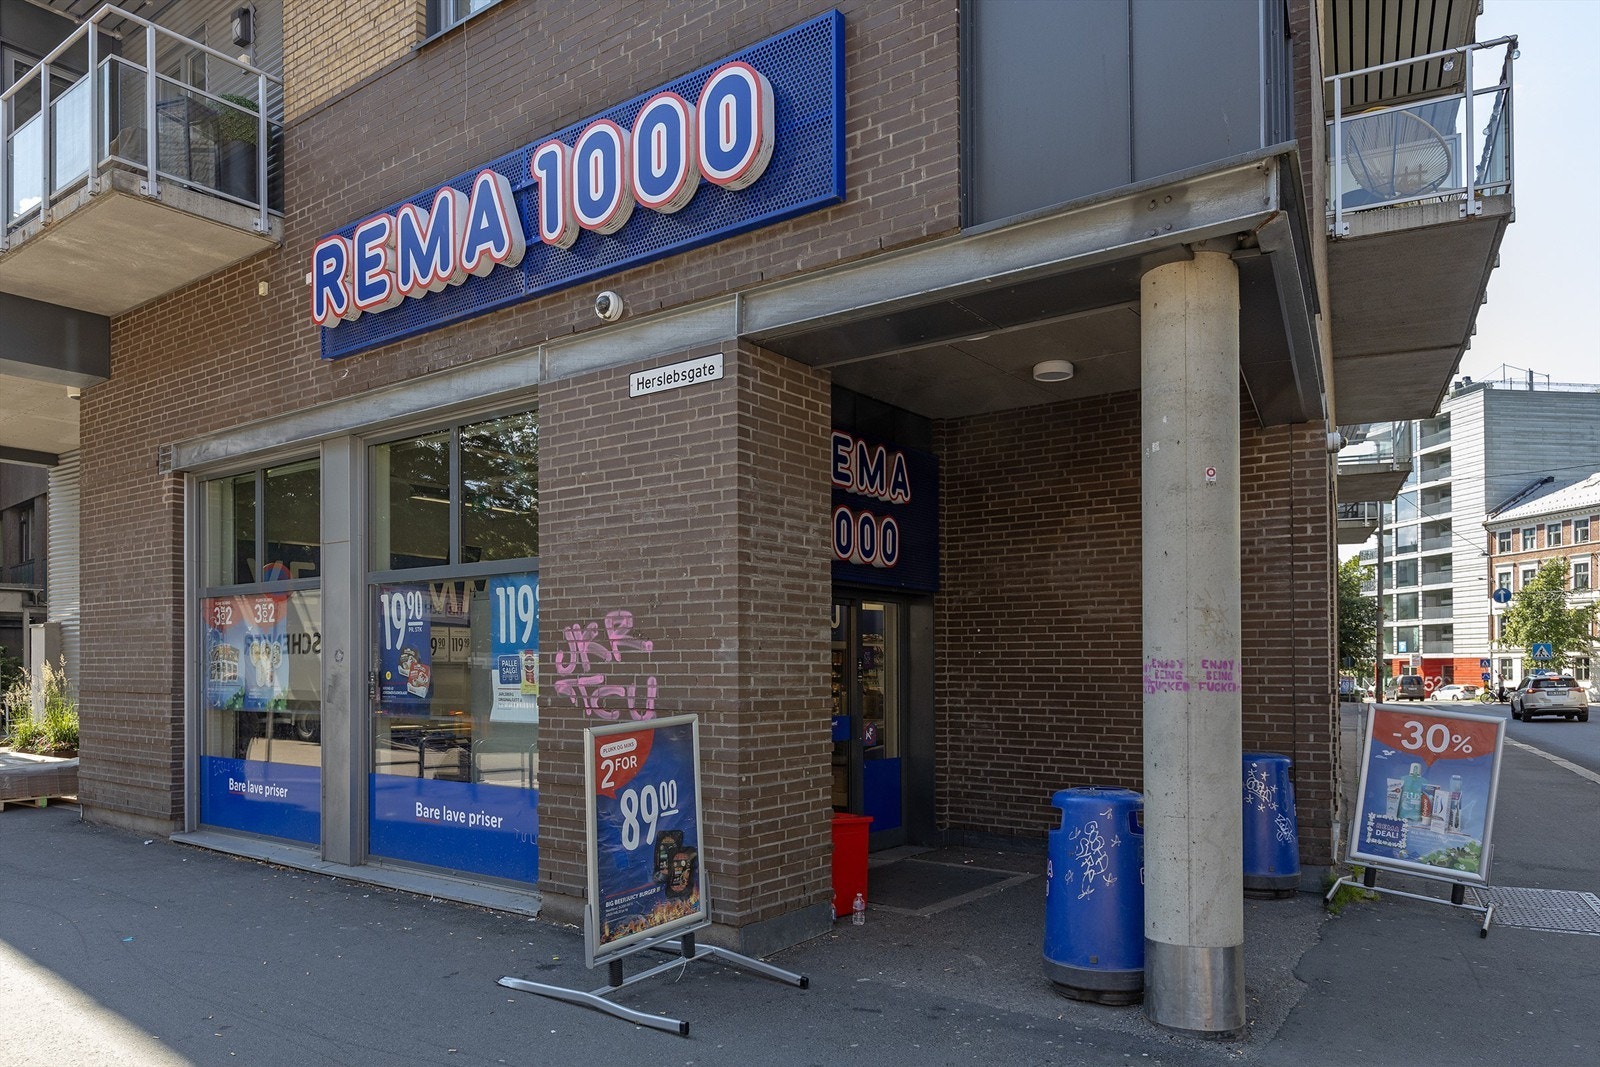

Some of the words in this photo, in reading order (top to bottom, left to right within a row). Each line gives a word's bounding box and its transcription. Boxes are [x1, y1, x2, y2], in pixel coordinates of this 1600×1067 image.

[311, 168, 521, 327] REMA
[531, 61, 771, 248] 1000
[636, 363, 715, 391] Herslebsgate
[831, 430, 911, 504] EMA
[831, 505, 900, 567] 000
[431, 637, 438, 656] 9
[502, 659, 518, 668] PALLE
[502, 666, 518, 675] SALG!
[1202, 659, 1234, 670] ENJOY
[1393, 720, 1473, 754] -30%
[615, 755, 638, 771] FOR
[228, 777, 246, 793] Bare
[246, 781, 263, 796] lave
[264, 784, 288, 798] priser
[415, 802, 440, 820] Bare
[443, 806, 466, 823] lave
[468, 810, 503, 829] priser
[1375, 829, 1399, 839] DEAL!
[605, 900, 614, 908] BIG
[639, 887, 656, 898] BURGER
